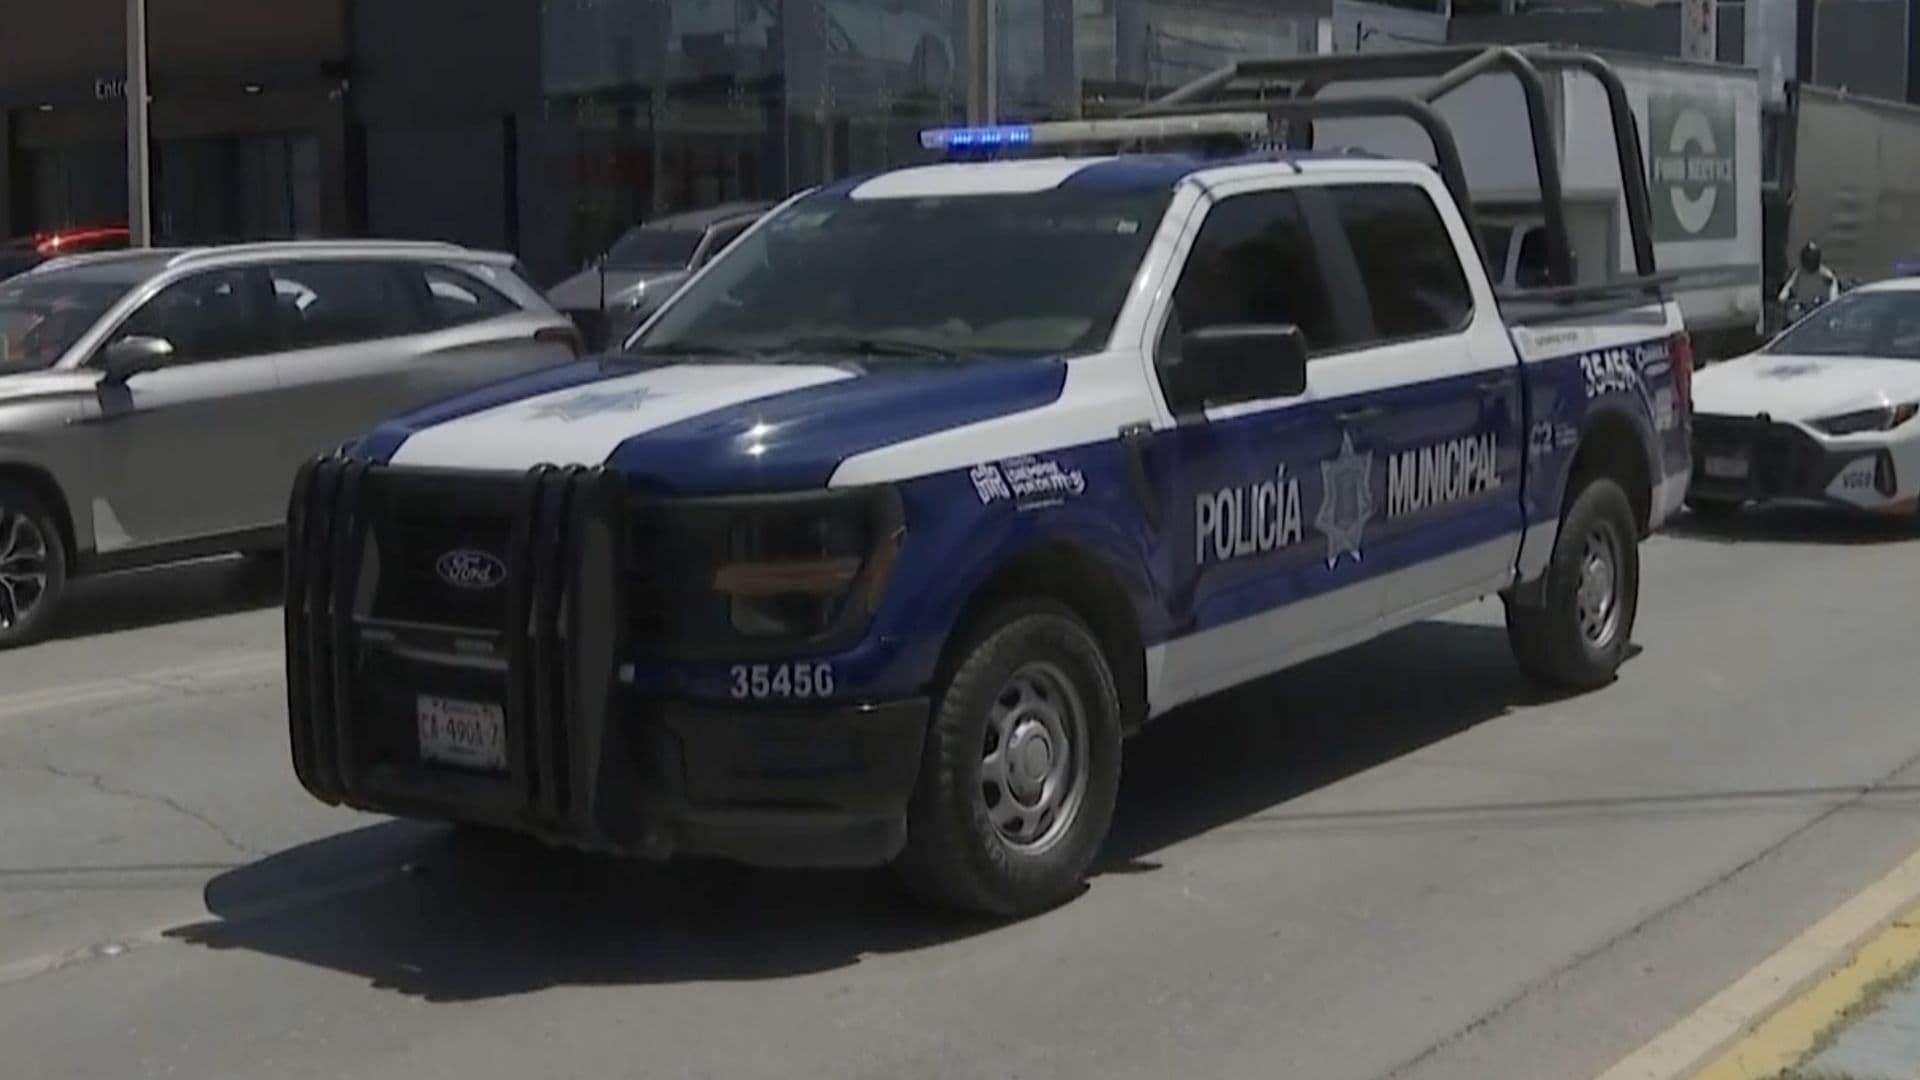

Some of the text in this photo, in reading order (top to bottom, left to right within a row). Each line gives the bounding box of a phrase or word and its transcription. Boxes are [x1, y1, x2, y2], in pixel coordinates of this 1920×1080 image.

[1196, 432, 1501, 564] POLICÍA MUNICIPAL
[447, 555, 493, 582] Ford
